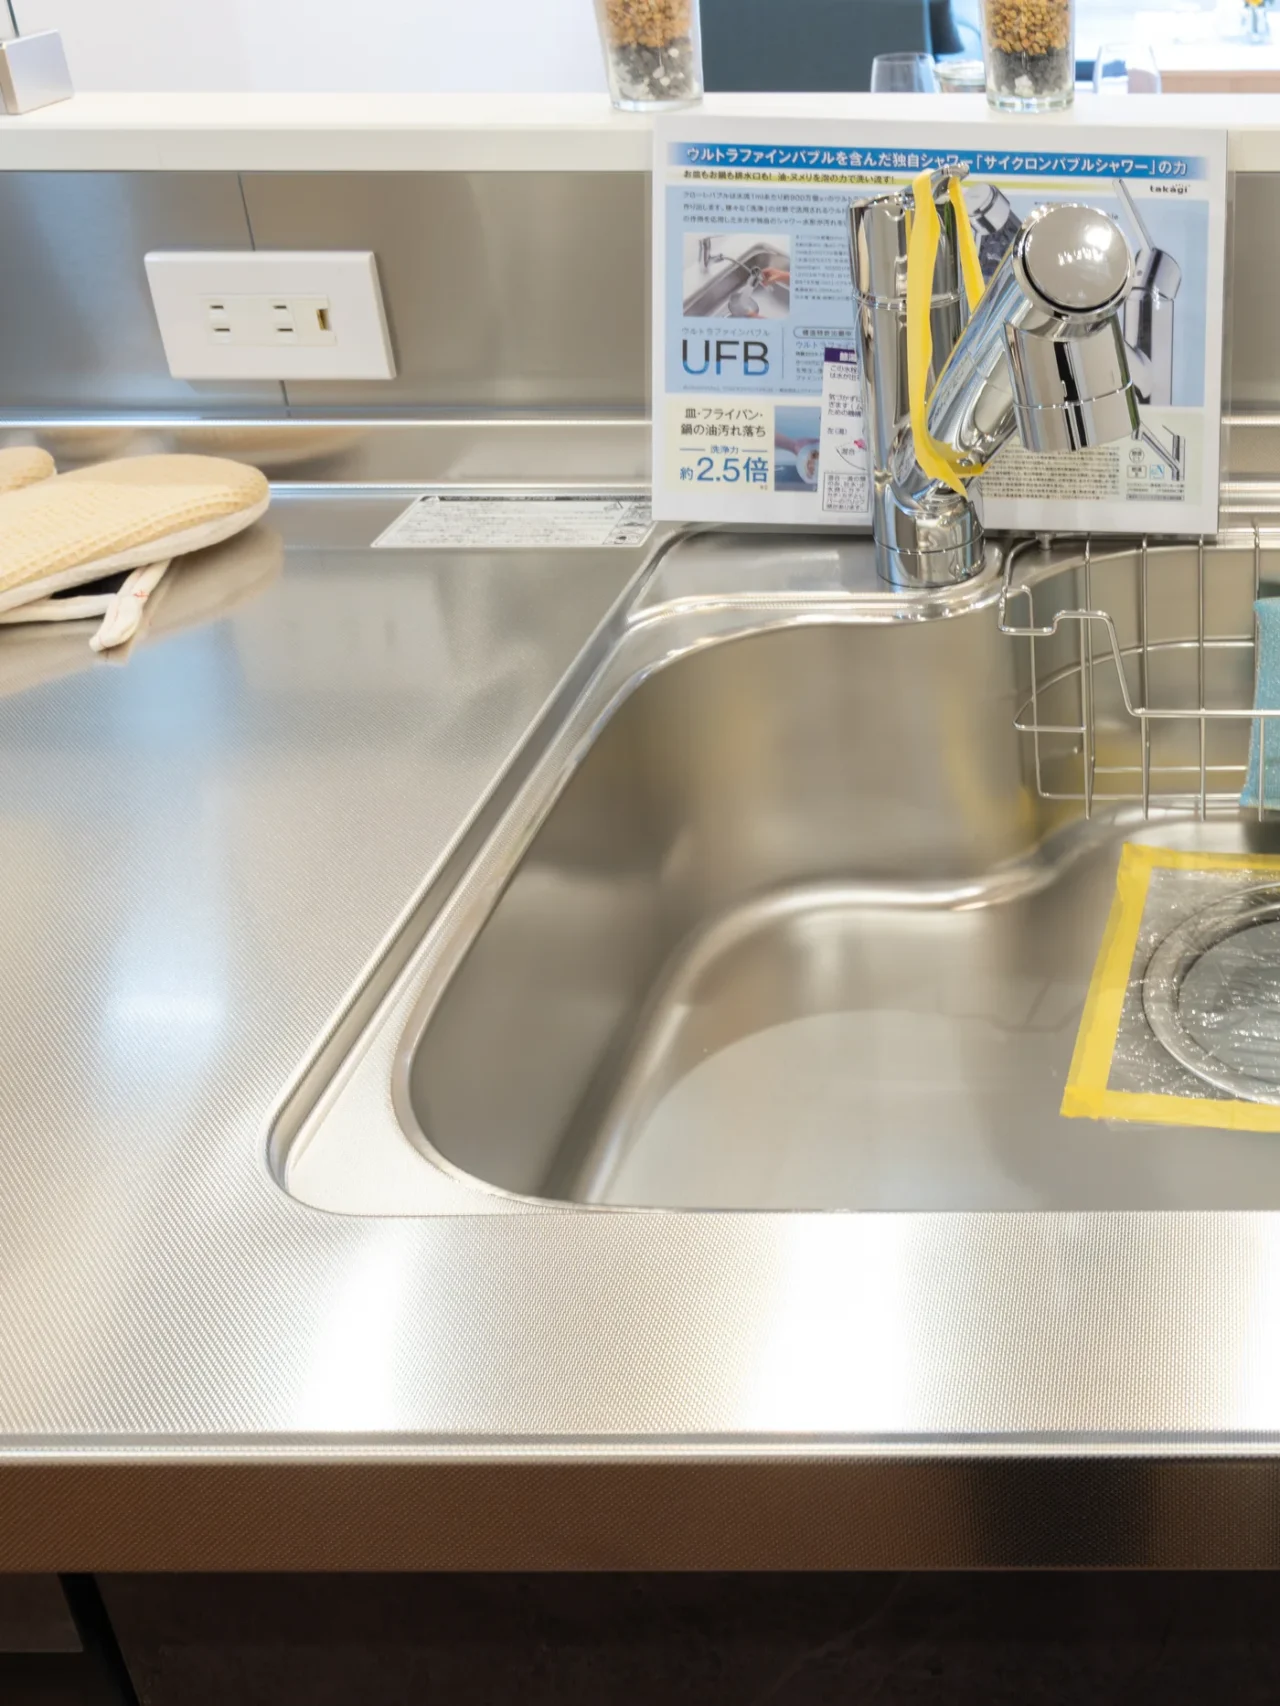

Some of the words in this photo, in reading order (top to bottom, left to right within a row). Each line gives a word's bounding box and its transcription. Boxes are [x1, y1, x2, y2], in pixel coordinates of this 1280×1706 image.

[1150, 185, 1188, 195] takagi
[682, 339, 770, 376] UFB
[681, 424, 766, 438] 鍋の油汚れ落ち
[711, 445, 739, 454] 洗浄力
[680, 456, 769, 483] 約2.5倍
